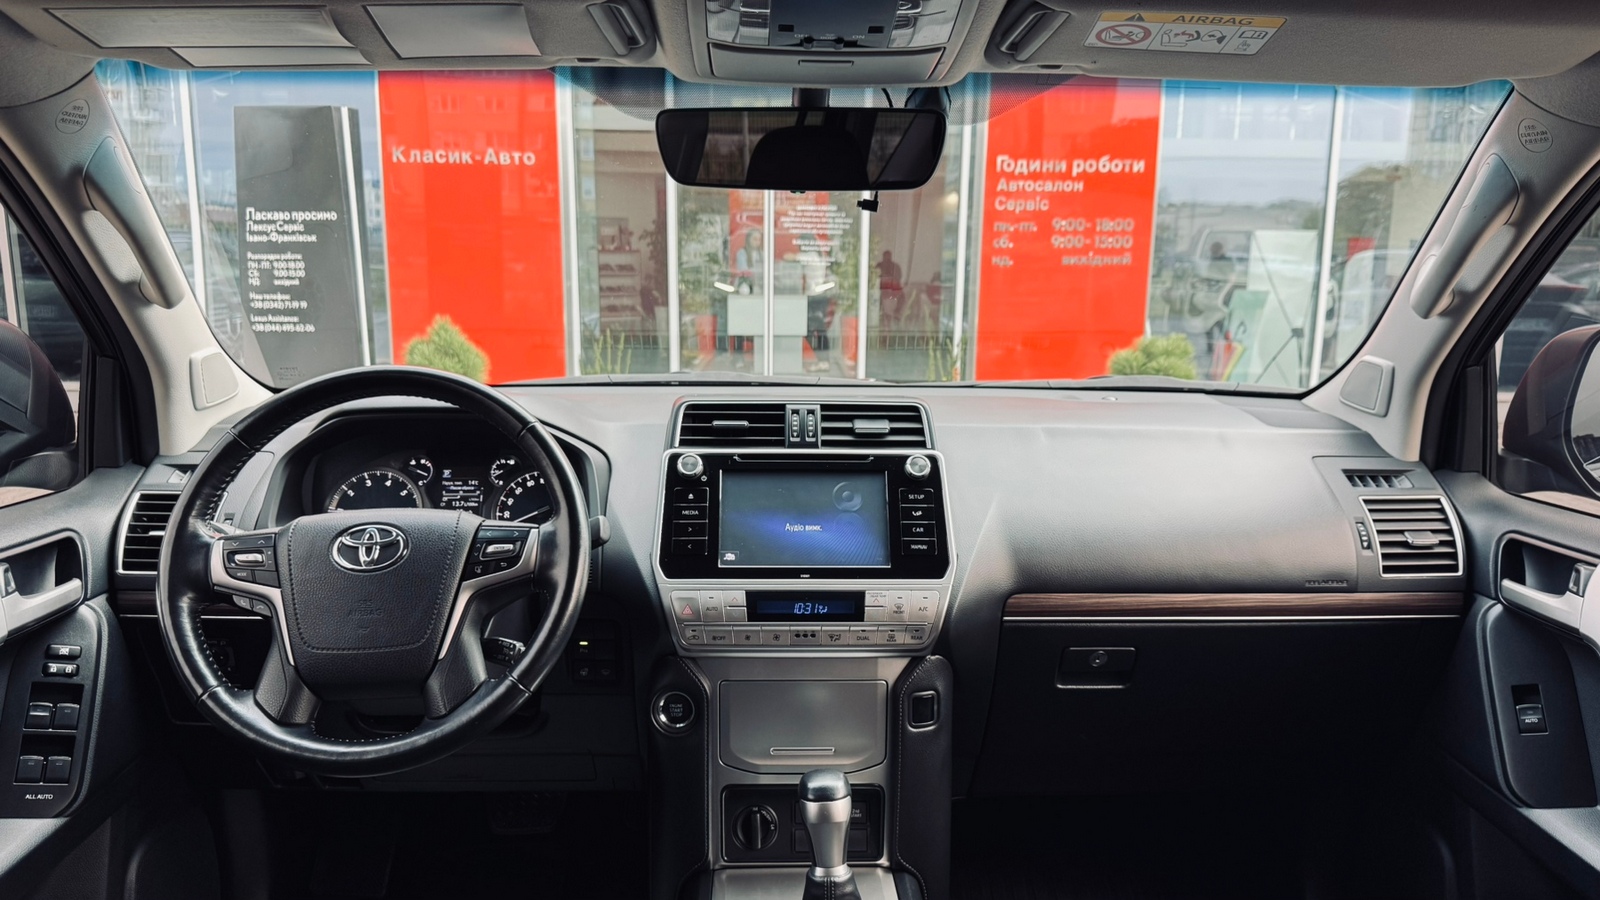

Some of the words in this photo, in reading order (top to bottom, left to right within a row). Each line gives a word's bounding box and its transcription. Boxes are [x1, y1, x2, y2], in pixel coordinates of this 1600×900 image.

[1172, 15, 1255, 26] AIRBAG
[392, 145, 536, 166] Класик-Авто
[996, 155, 1067, 176] Години
[1071, 155, 1145, 177] роботи
[996, 177, 1084, 192] Автосалон
[994, 196, 1049, 214] Сервіс
[246, 207, 290, 221] Ласкаво
[291, 210, 338, 223] просимо
[276, 220, 305, 233] Сервіс
[246, 231, 318, 244] Івано-Франківськ
[993, 234, 1014, 248] сб.
[1061, 251, 1132, 267] вихідний
[400, 489, 408, 497] 5
[785, 523, 804, 532] Аудіо
[794, 602, 818, 615] 10:31
